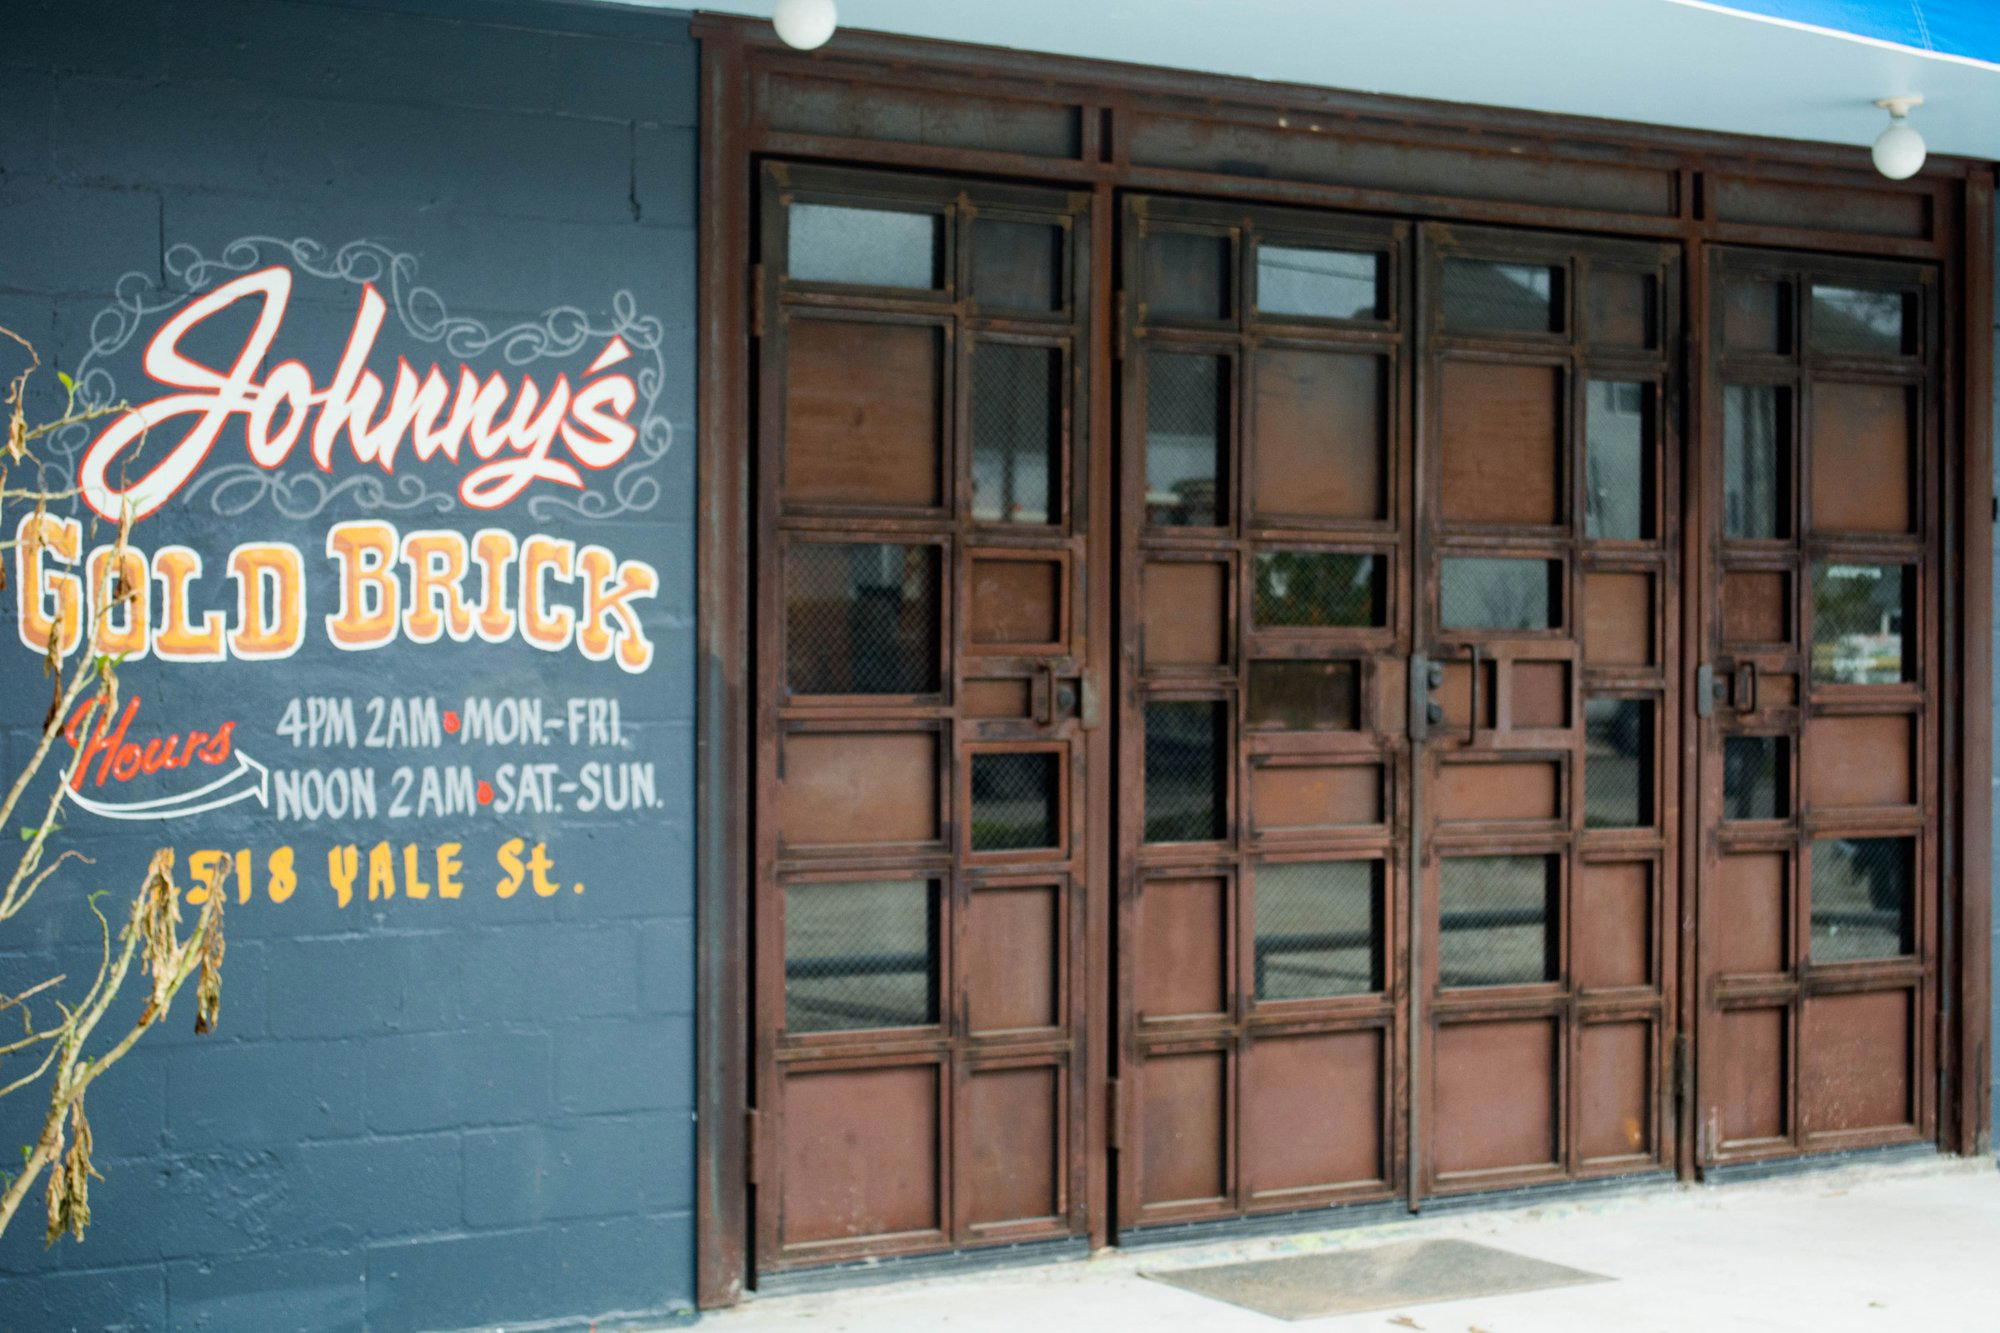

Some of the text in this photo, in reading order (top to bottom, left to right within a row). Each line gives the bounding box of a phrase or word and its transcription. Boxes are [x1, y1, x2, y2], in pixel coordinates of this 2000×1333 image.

[79, 266, 638, 522] Johnny's
[16, 511, 660, 674] GOLD BRICK
[65, 694, 236, 793] Hours
[276, 696, 357, 748] 4PM
[364, 696, 441, 748] 2AM
[274, 767, 377, 821] NOON
[388, 765, 478, 818] 2AM
[328, 841, 463, 909] YALE
